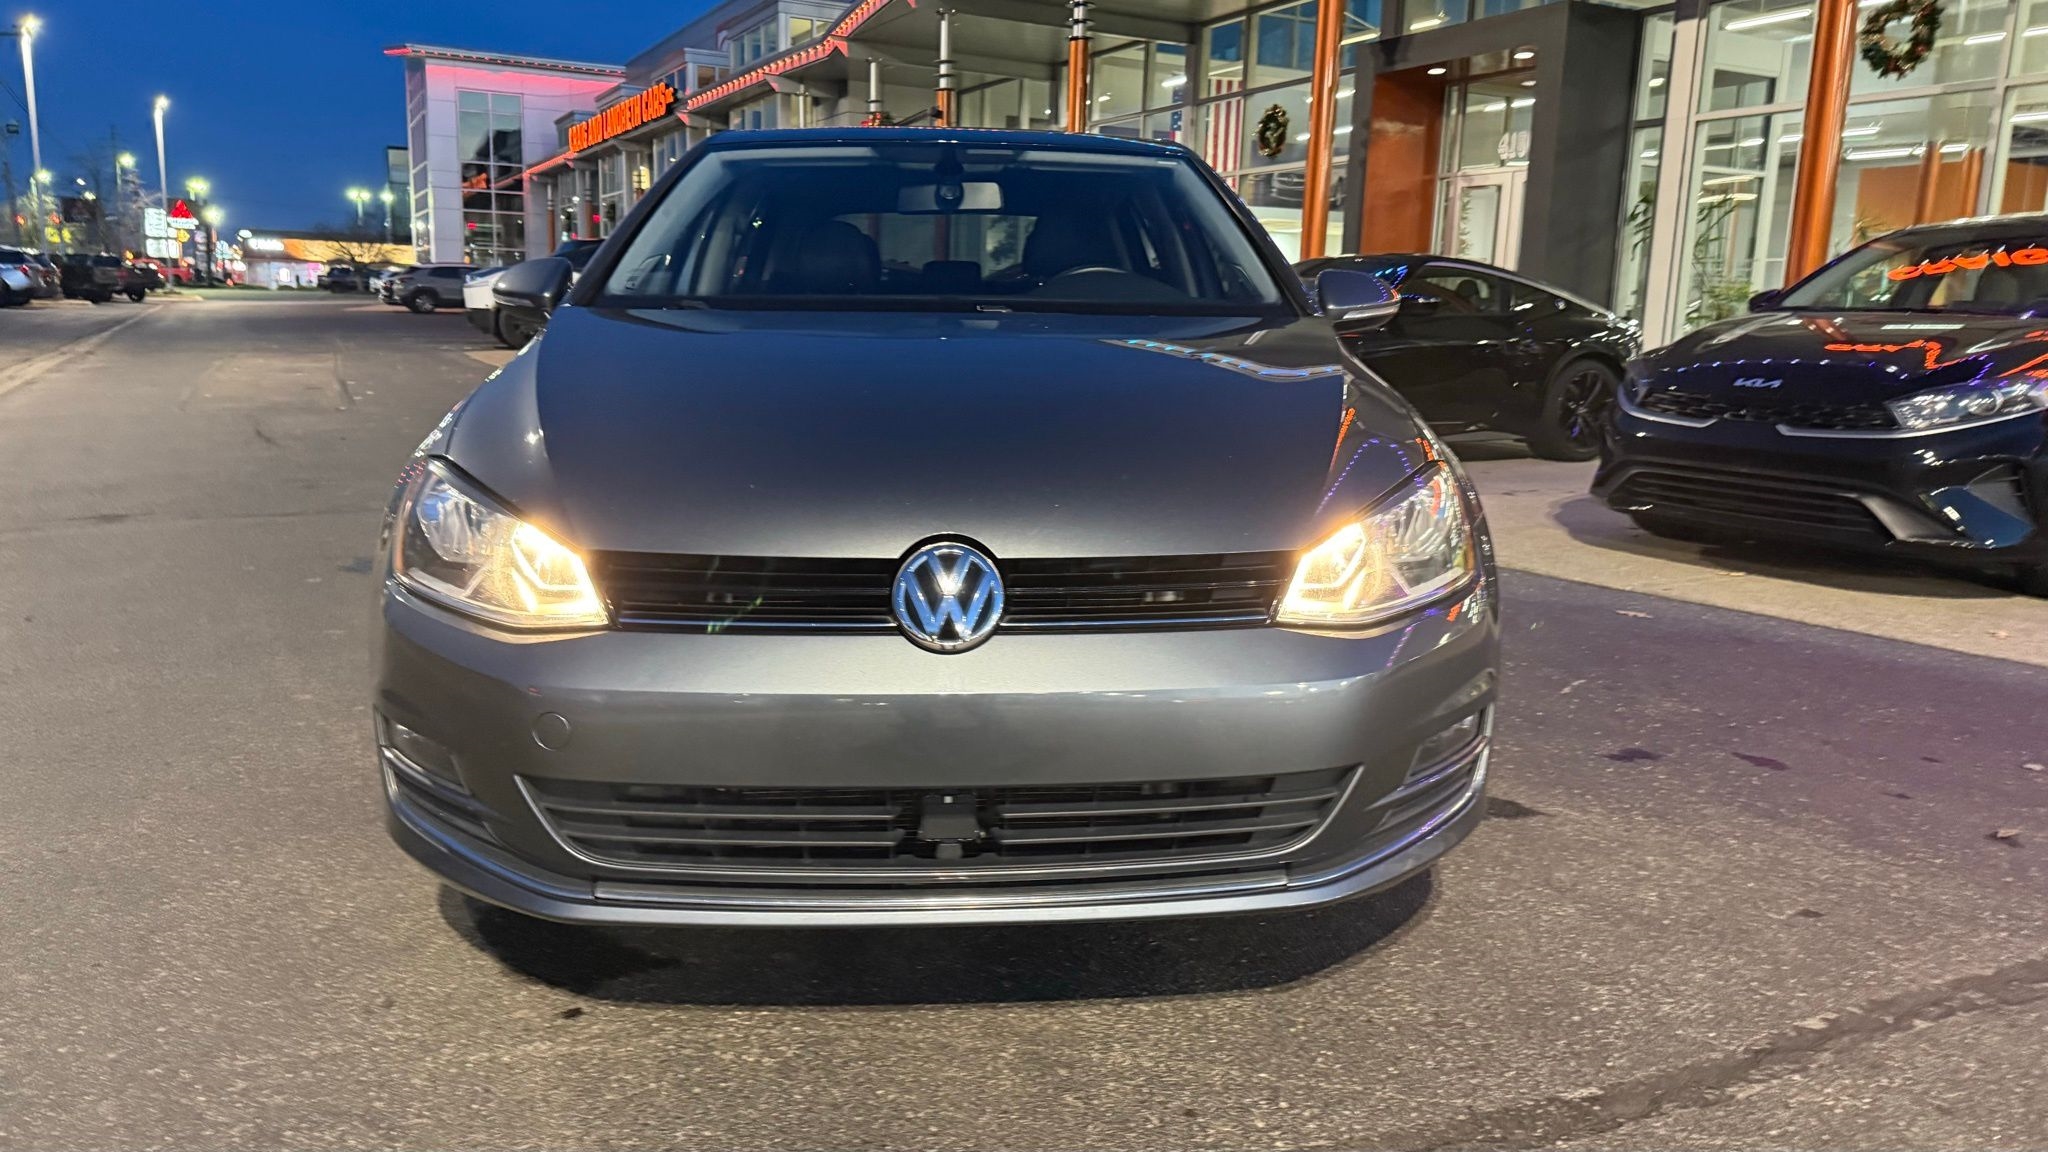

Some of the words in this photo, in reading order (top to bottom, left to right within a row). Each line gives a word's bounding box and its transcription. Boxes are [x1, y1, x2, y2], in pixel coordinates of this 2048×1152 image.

[587, 114, 603, 147] AND
[602, 94, 641, 140] LANDRETH
[641, 82, 666, 122] CARS
[899, 549, 1001, 643] VW
